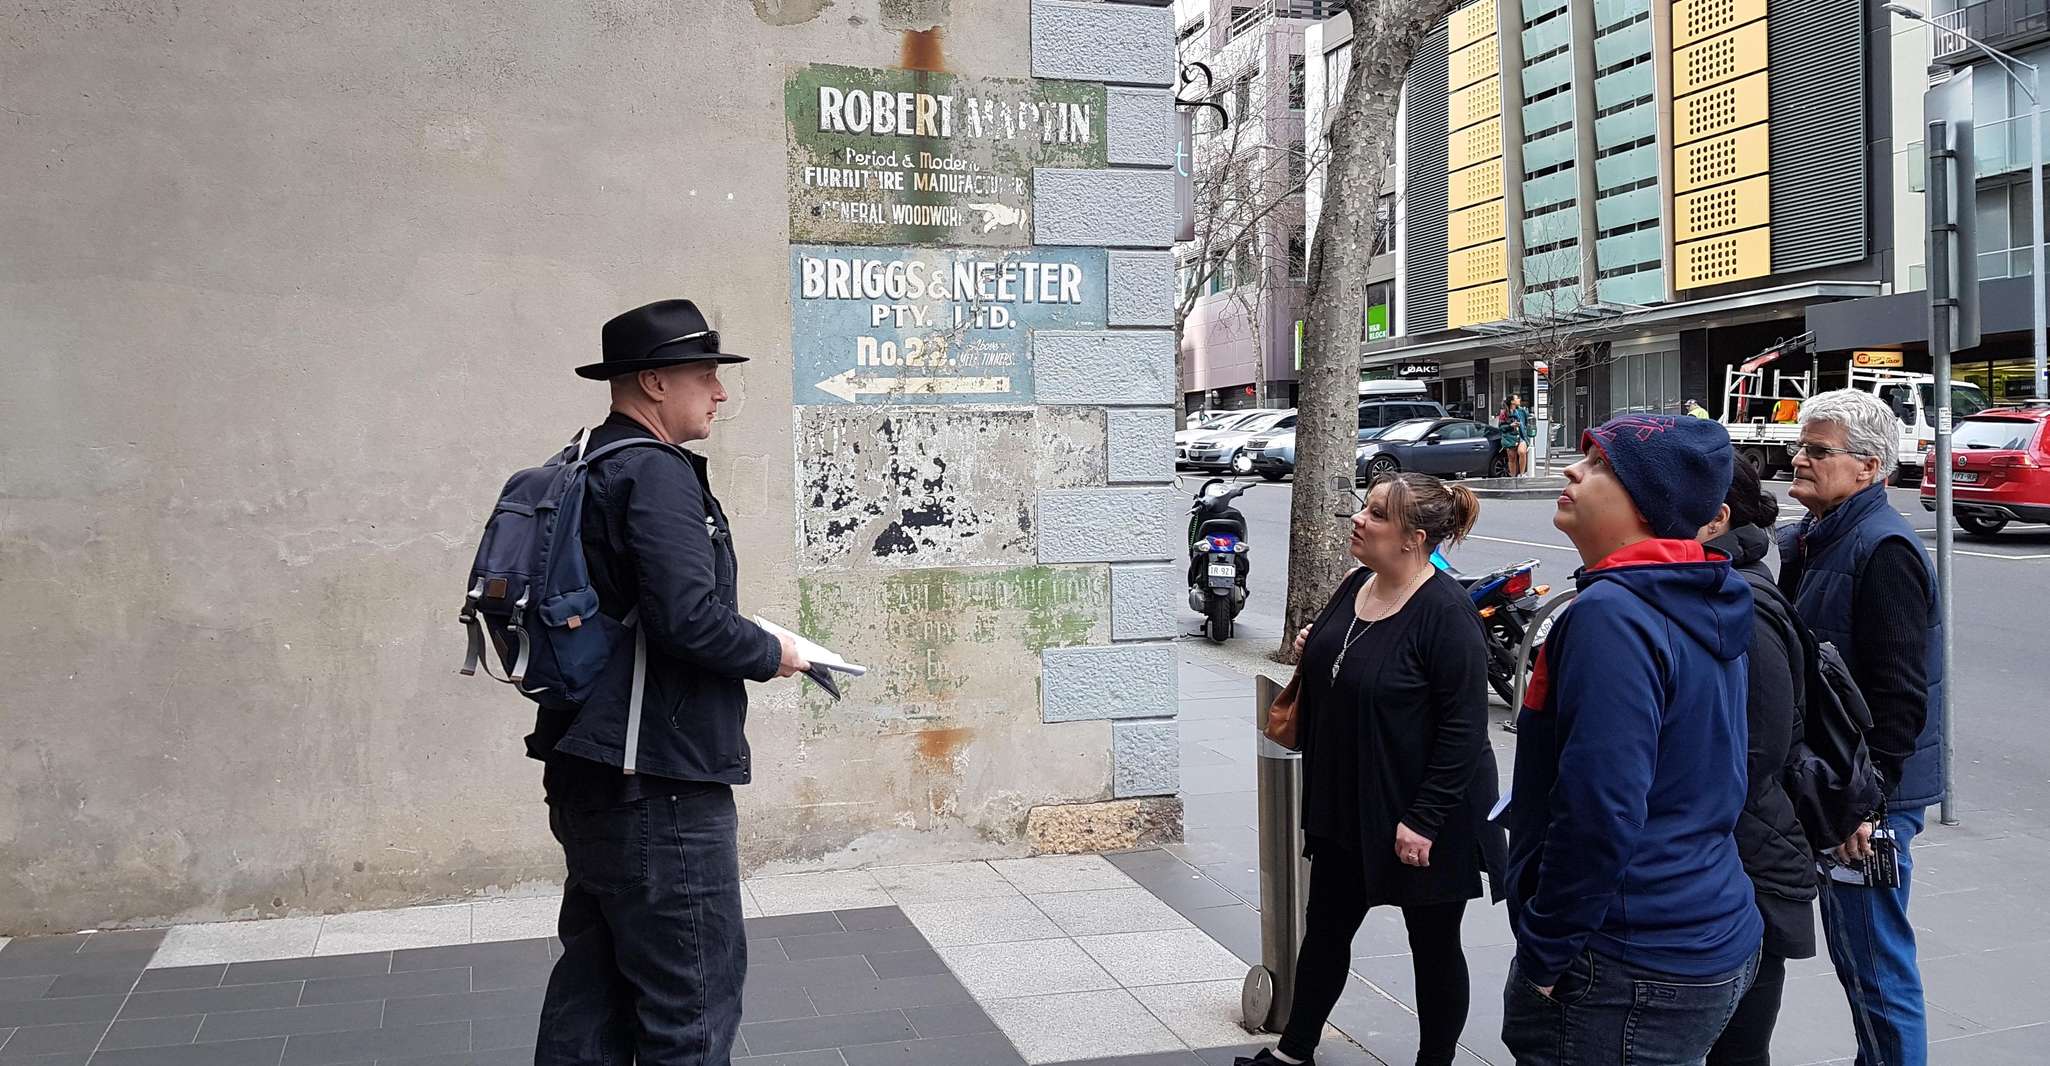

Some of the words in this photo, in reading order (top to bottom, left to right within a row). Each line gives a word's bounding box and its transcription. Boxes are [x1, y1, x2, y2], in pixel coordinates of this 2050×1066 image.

[819, 86, 953, 137] ROBERT
[966, 97, 1091, 143] MARTIN
[846, 147, 899, 168] Period
[902, 154, 916, 169] &
[804, 166, 904, 191] FURNITURE
[913, 172, 1025, 196] MANUFACUR
[800, 257, 926, 299] BRIGGS
[928, 270, 950, 299] &
[952, 261, 1082, 304] NEETER
[870, 304, 933, 328] PTY.
[952, 305, 1017, 329] LTD.
